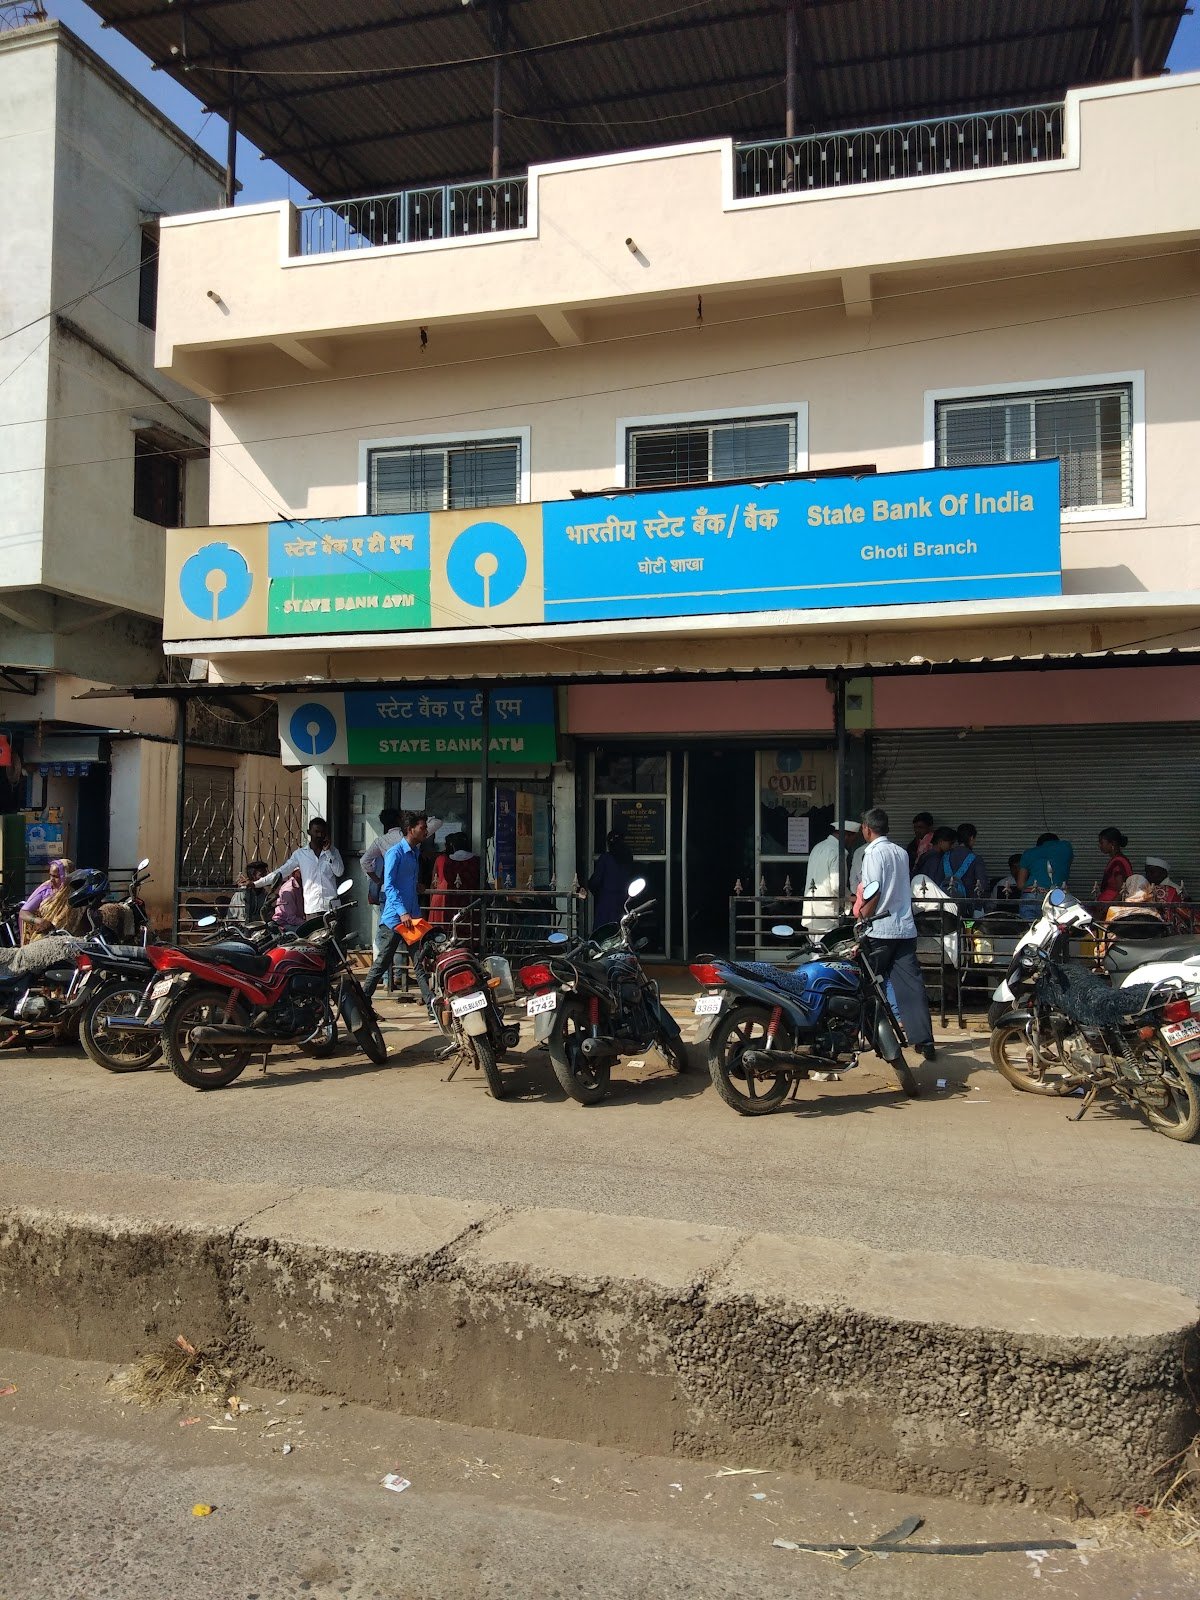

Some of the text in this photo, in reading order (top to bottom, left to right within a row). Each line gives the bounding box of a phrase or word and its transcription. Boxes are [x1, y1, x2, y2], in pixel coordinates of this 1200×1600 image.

[807, 490, 1035, 527] State Bank Of India
[565, 515, 638, 545] भारतीय
[643, 510, 686, 539] स्टेट
[283, 537, 318, 558] स्टेट
[351, 538, 365, 557] ए
[367, 531, 386, 553] टी
[860, 539, 978, 561] Ghoti Branch
[637, 556, 704, 575] घोटी शाखा
[283, 593, 415, 614] STATE BANK ATM
[376, 696, 413, 719] स्टेट
[418, 695, 448, 718] बैंक
[452, 700, 465, 721] ए
[495, 699, 522, 720] एम
[379, 739, 431, 753] STATE
[435, 738, 482, 752] BANK
[528, 1000, 554, 1014] 4742
